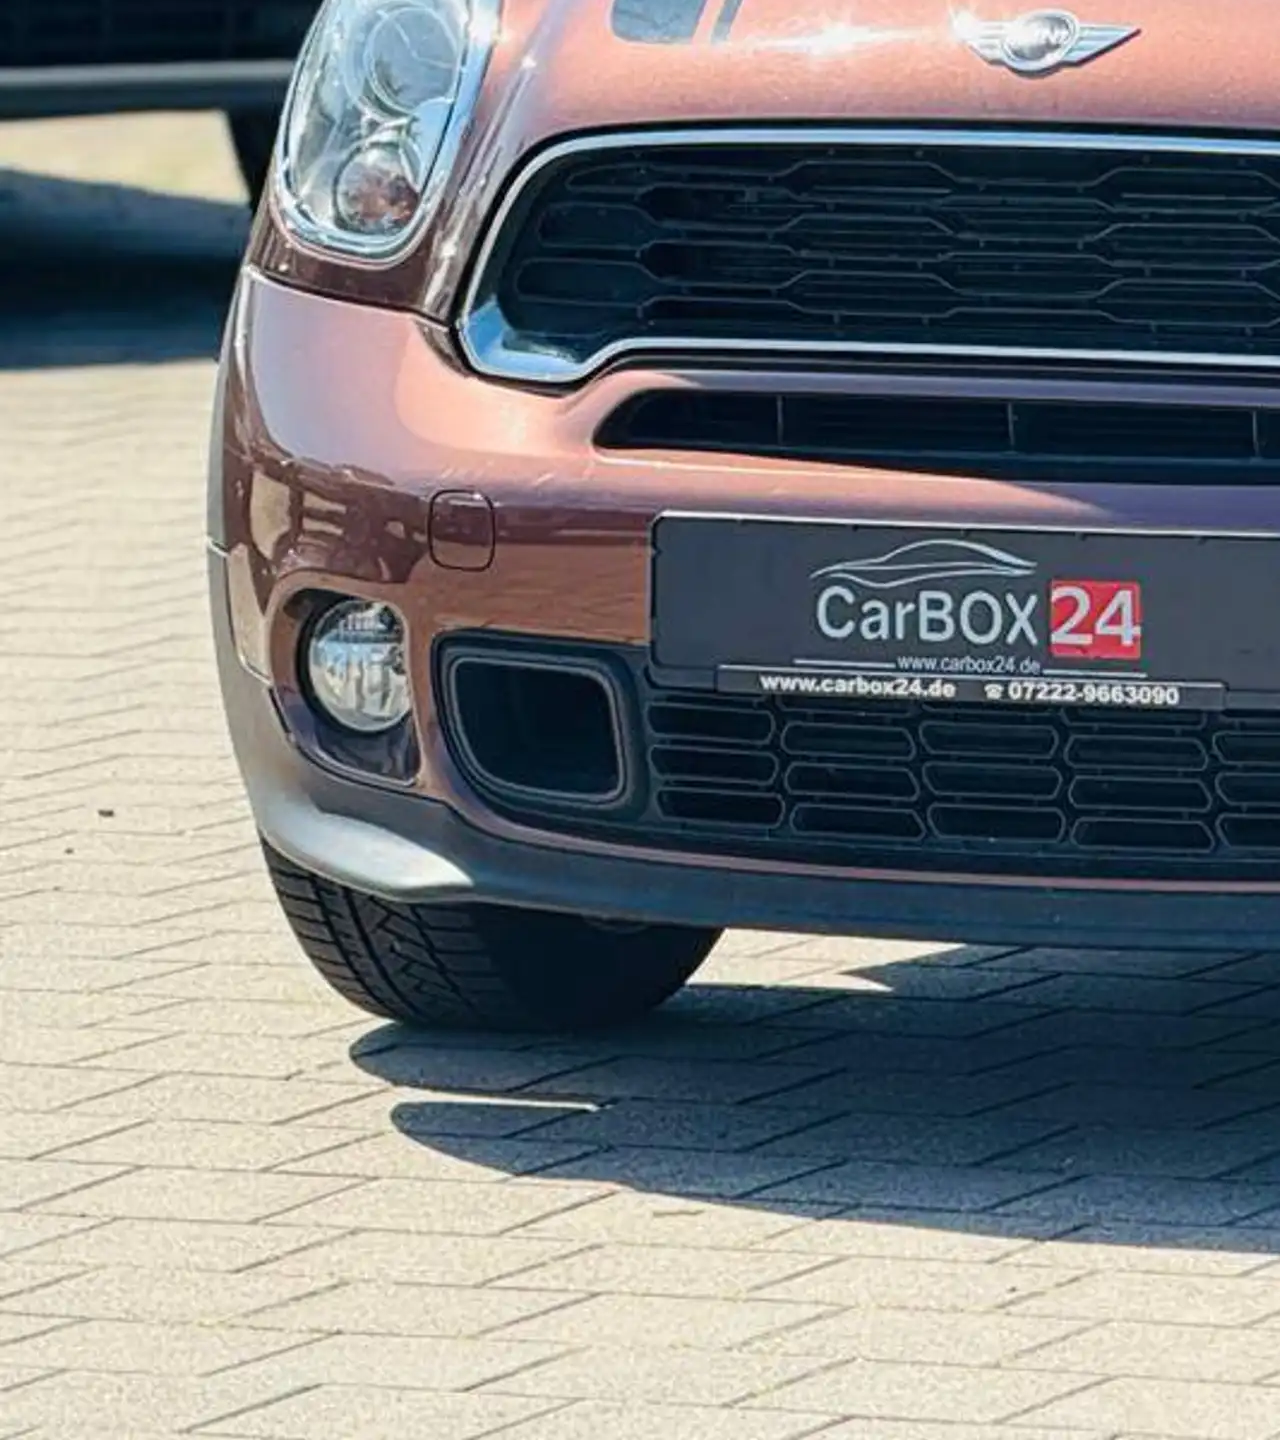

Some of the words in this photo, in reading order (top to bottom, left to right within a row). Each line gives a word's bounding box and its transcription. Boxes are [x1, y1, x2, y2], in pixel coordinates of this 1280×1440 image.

[897, 654, 1041, 676] www.carbox24.de
[759, 674, 956, 698] www.carbox24.de
[1007, 681, 1180, 706] 07222-9663090
